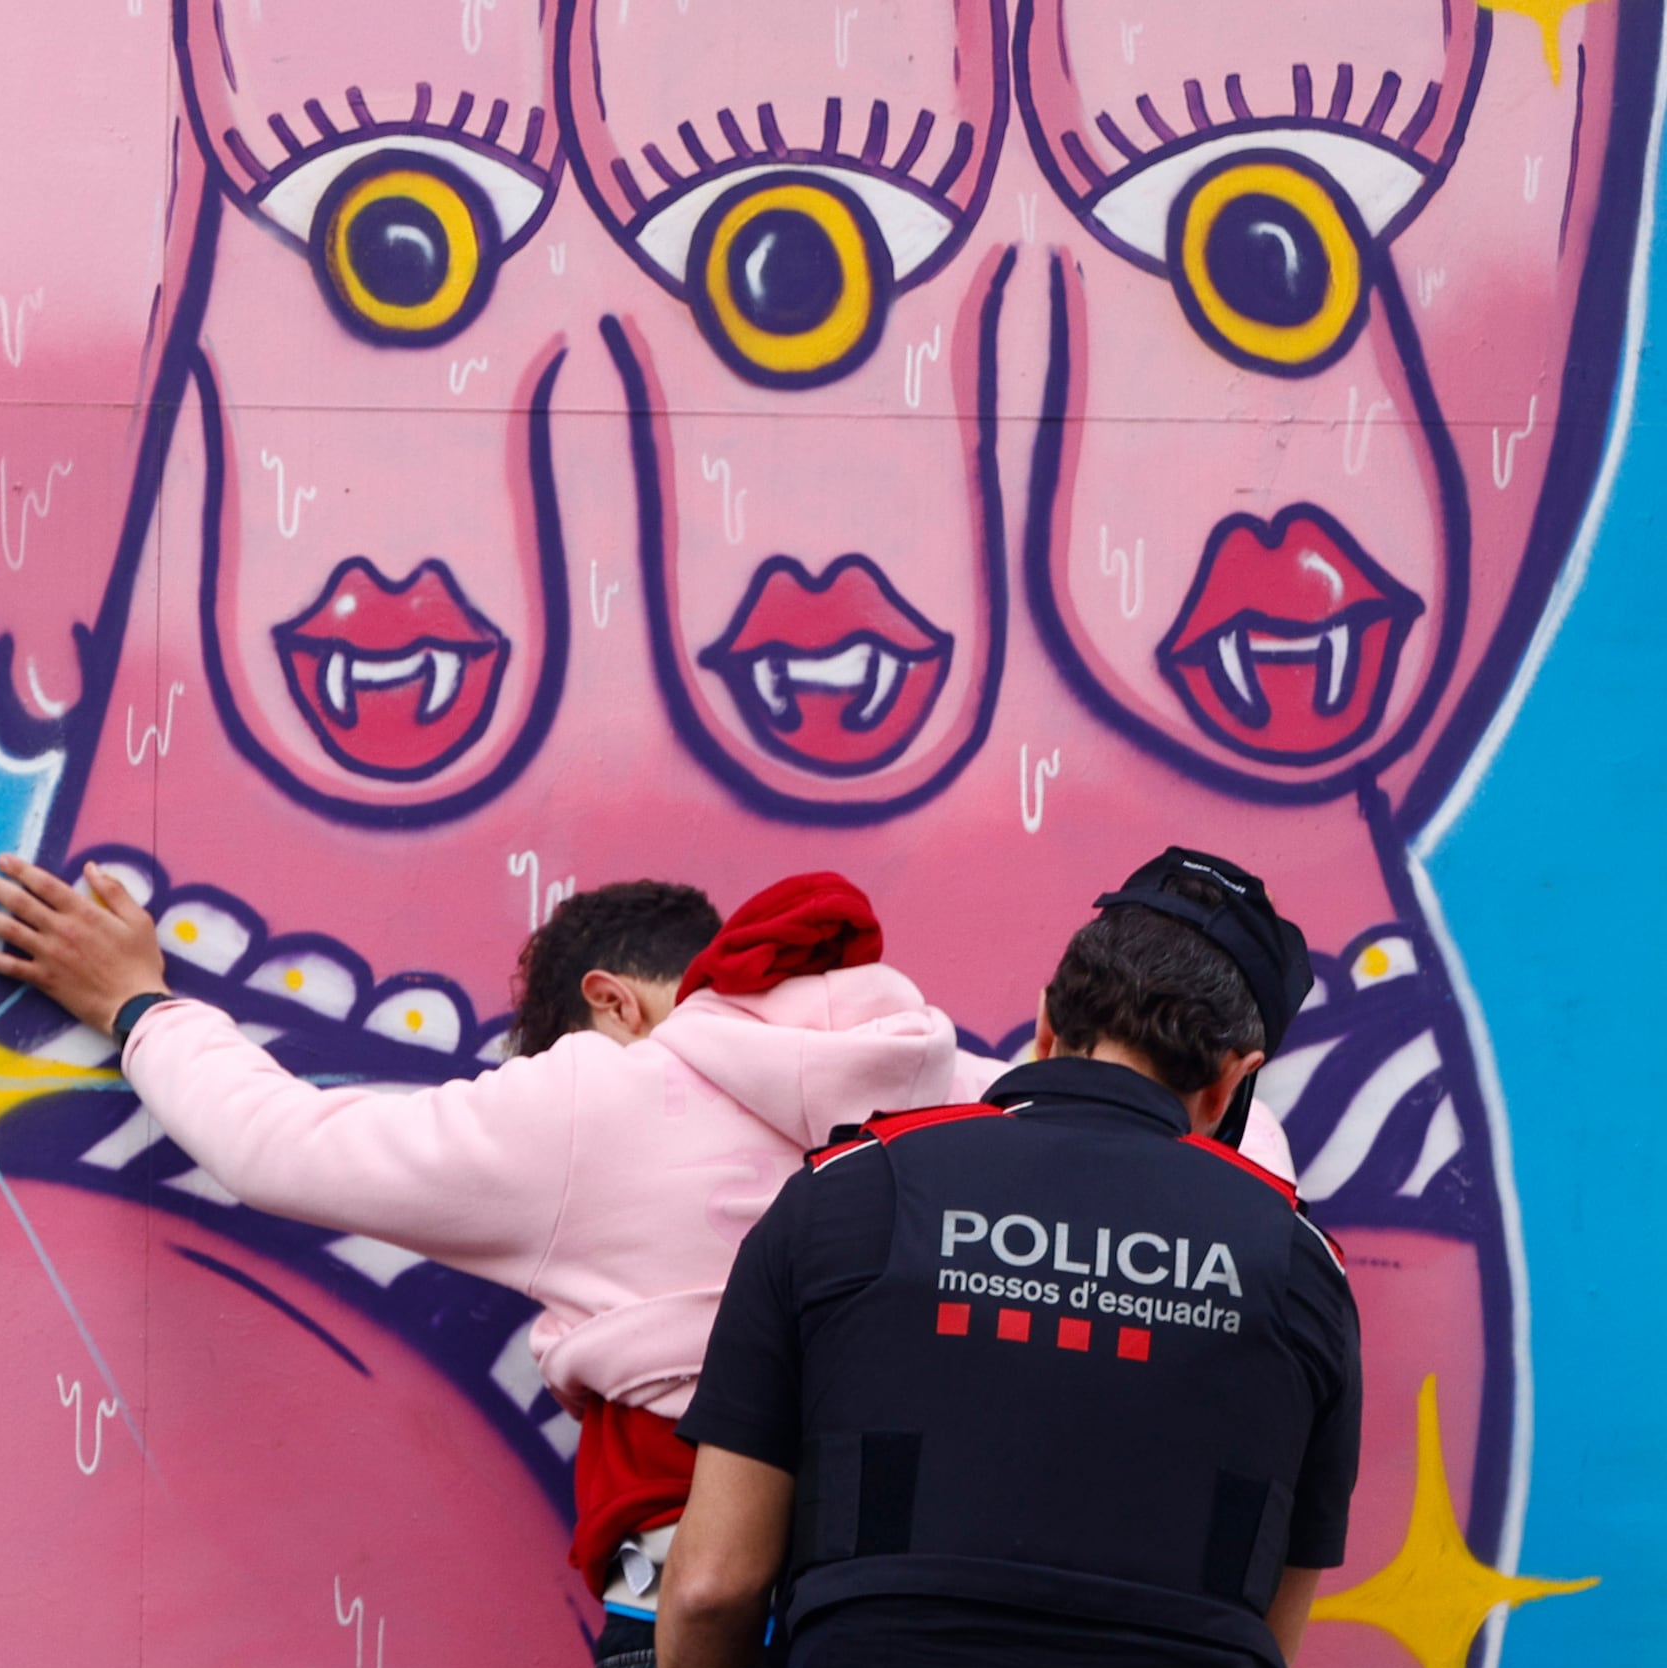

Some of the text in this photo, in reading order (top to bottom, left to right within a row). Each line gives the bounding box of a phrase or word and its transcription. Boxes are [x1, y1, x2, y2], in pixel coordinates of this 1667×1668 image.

[940, 1210, 1243, 1298] POLICIA
[938, 1269, 1241, 1335] mossos d'esquadra
